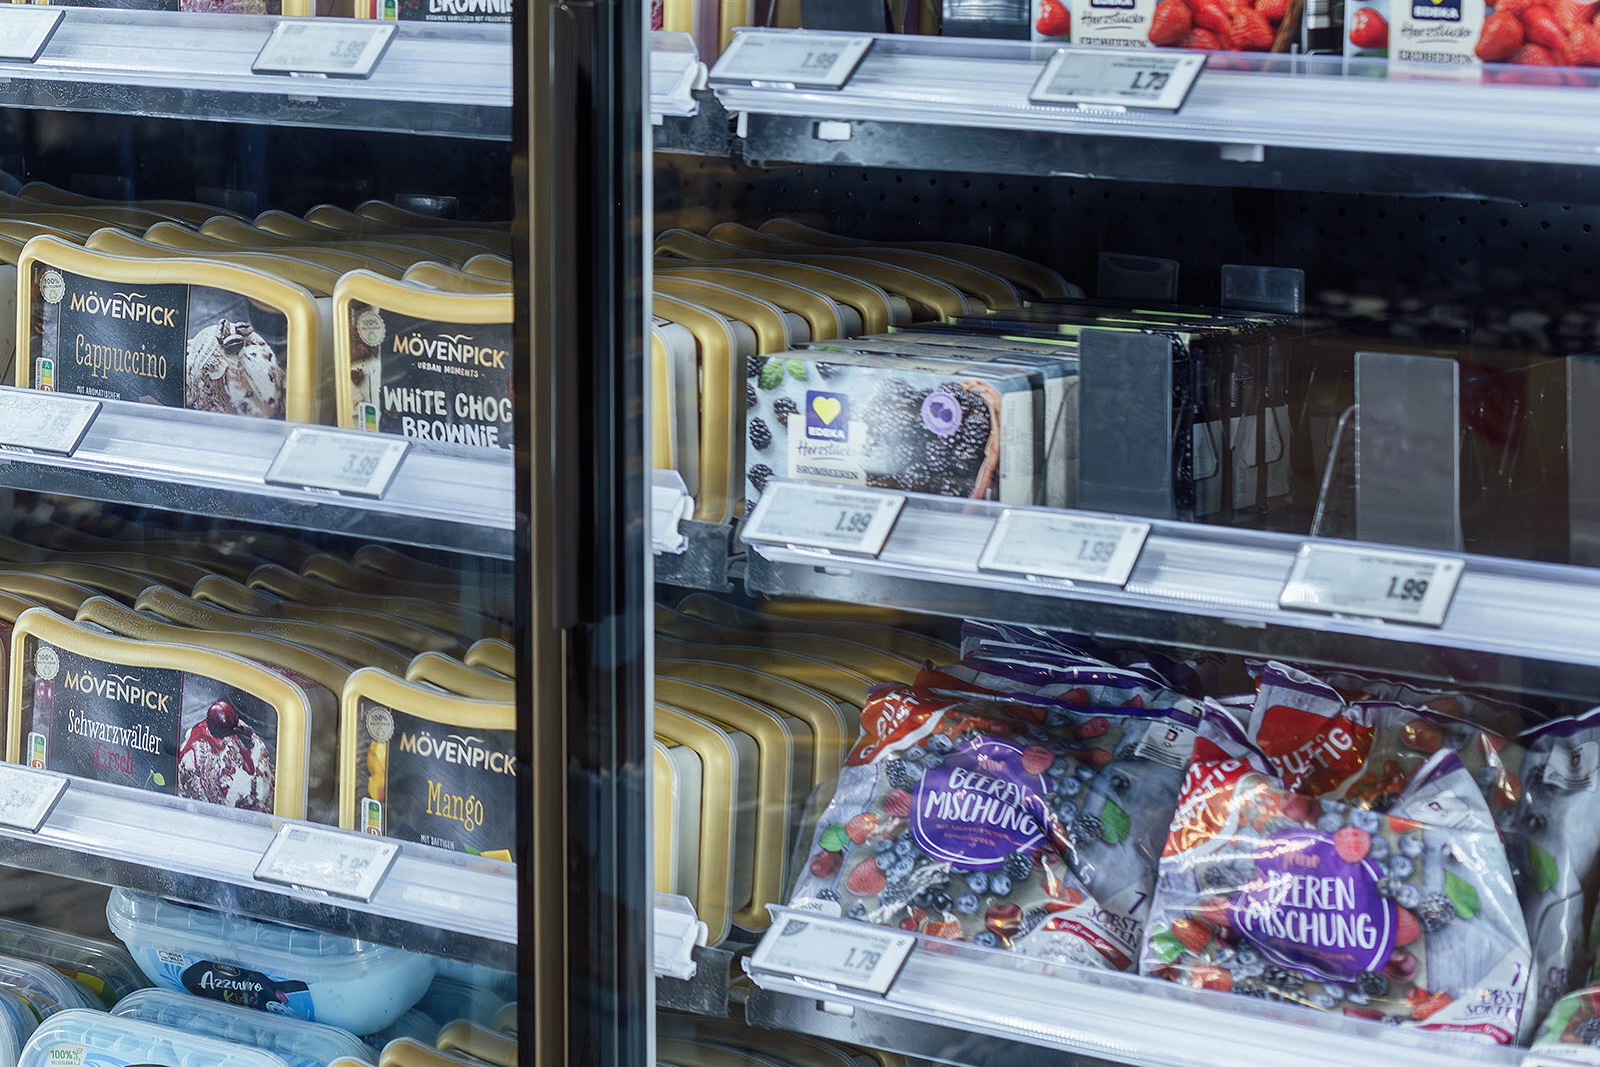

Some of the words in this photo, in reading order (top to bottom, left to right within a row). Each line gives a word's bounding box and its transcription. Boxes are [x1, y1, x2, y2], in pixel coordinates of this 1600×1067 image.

[70, 290, 175, 328] MÖVENPICK
[75, 333, 167, 380] Cappuccino
[392, 332, 506, 370] MÖVENPICK
[417, 361, 442, 373] URBAN
[443, 366, 479, 378] MOMENTS
[383, 385, 448, 416] WHITE
[455, 393, 512, 423] CHOC
[835, 510, 873, 533] 1.99
[1385, 576, 1429, 603] 1.99
[65, 669, 169, 714] MÖVENPICK
[68, 708, 162, 755] Schwarzwälder
[92, 742, 135, 776] Kirsch
[400, 730, 517, 777] MÖVENPICK
[425, 779, 485, 833] Mango
[948, 766, 1028, 808] BEEREN
[924, 788, 1038, 837] MISCHUNG
[1265, 869, 1356, 912] BEEREN
[1244, 906, 1378, 951] MISCHUNG
[842, 946, 881, 970] 1.79
[199, 970, 264, 992] Azzurro
[50, 1048, 78, 1062] 100%
